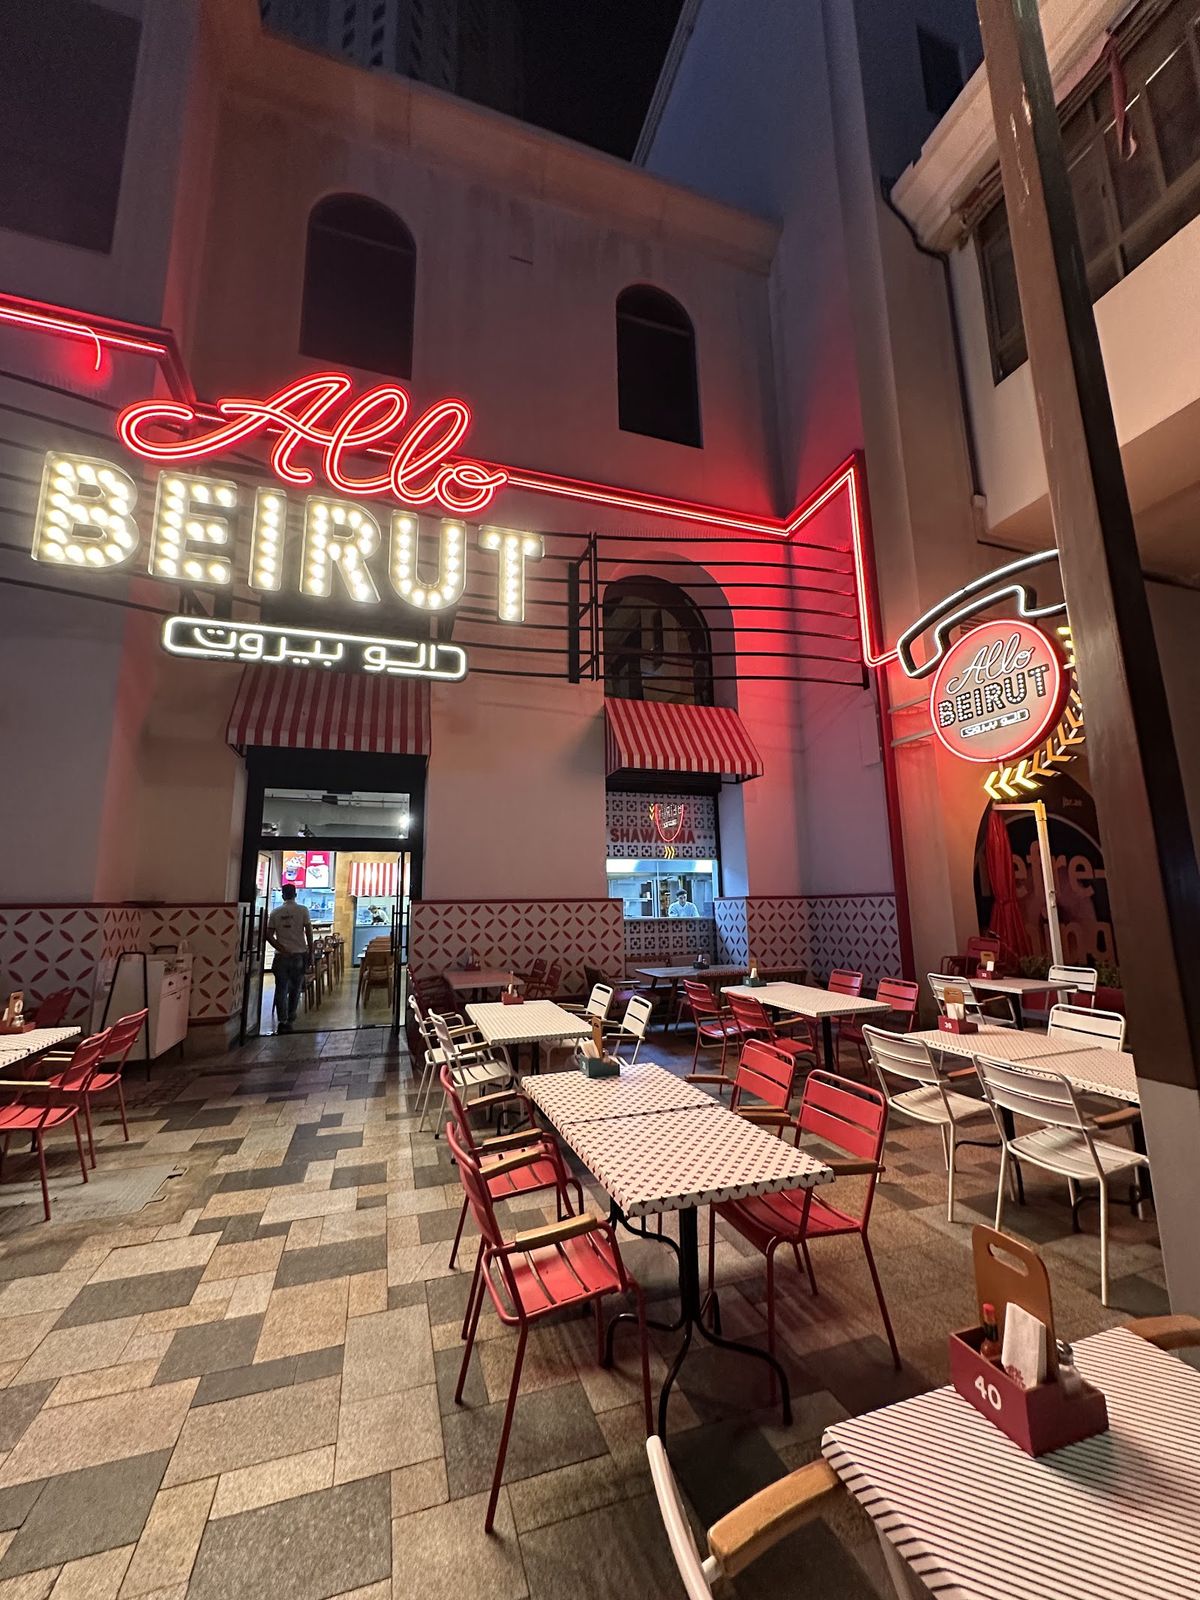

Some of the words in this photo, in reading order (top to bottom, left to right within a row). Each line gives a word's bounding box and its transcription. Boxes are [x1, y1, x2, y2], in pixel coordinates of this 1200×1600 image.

[117, 371, 508, 513] Allo
[30, 449, 546, 623] BEIRUT
[193, 626, 344, 667] بيروت
[363, 642, 436, 672] الو
[945, 632, 1035, 695] Allo
[937, 663, 1050, 728] BEIRUT
[974, 1375, 1002, 1410] 40
